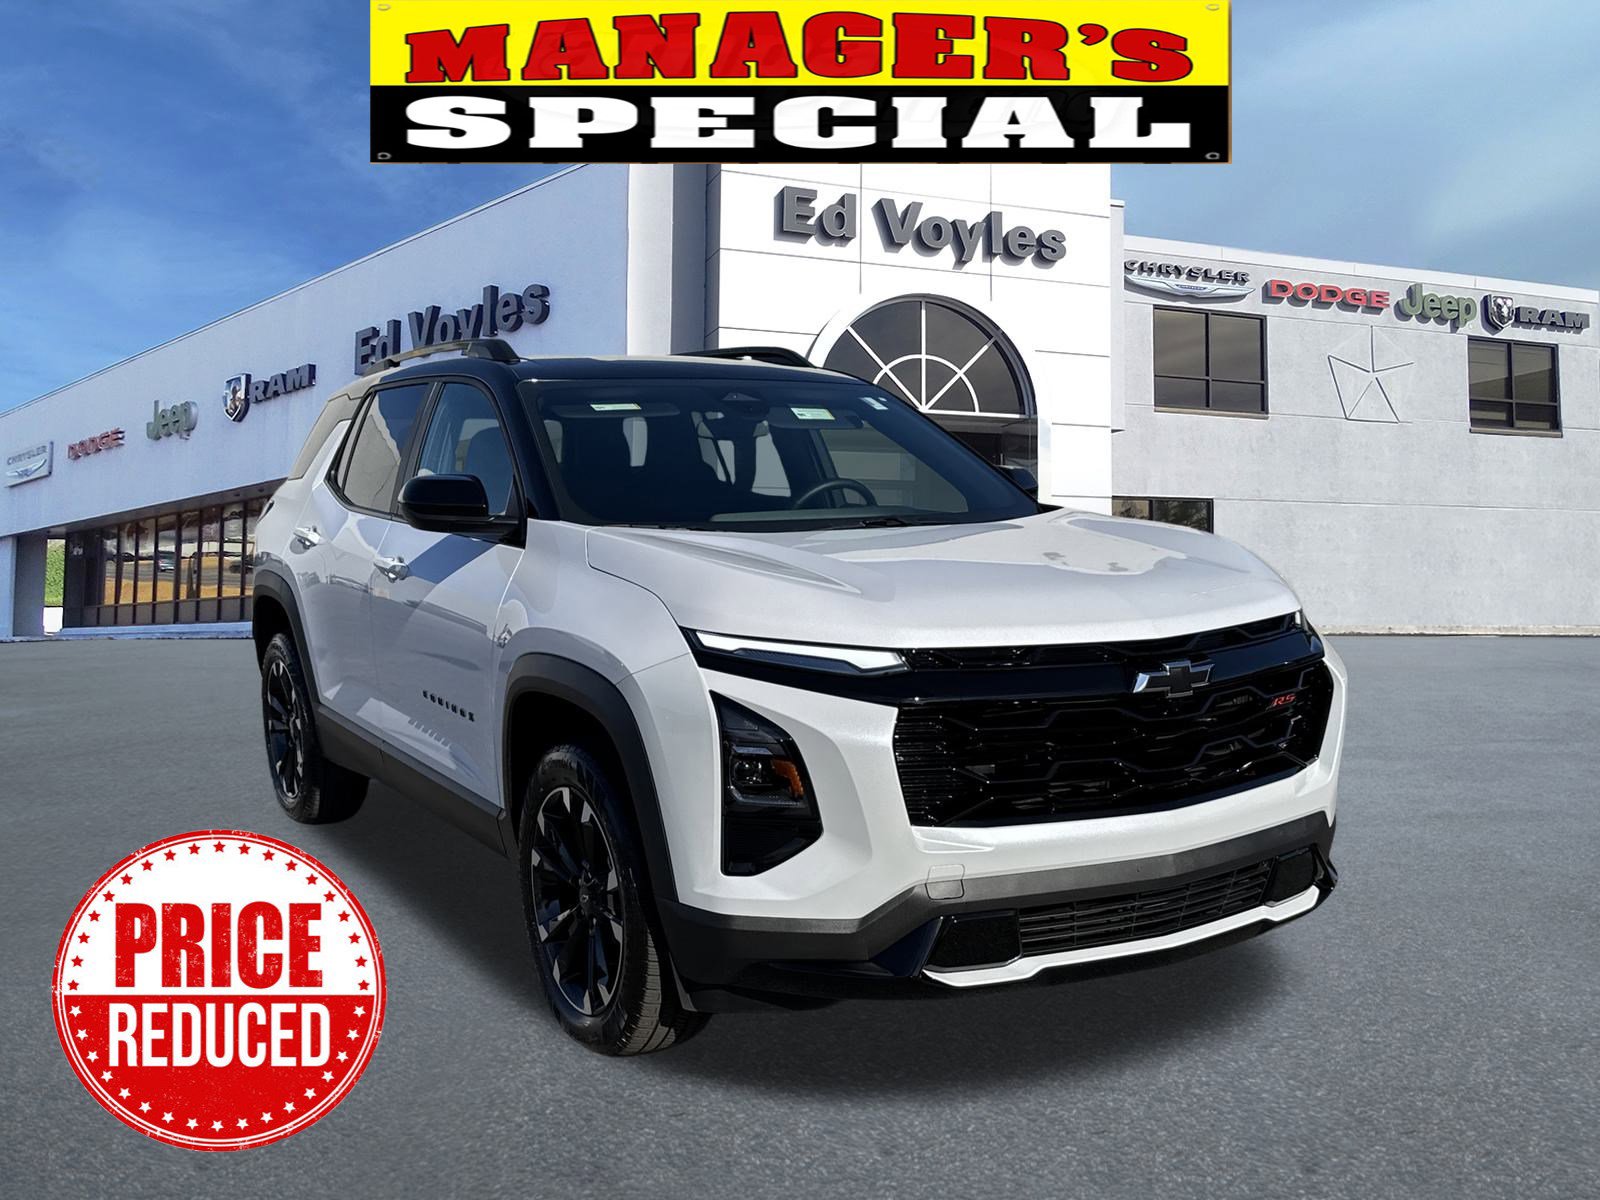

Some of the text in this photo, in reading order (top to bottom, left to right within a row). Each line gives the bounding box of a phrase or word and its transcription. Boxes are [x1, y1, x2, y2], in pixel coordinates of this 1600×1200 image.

[776, 186, 1067, 266] Ed Voyles
[1124, 259, 1251, 285] CHRYSLER
[1263, 279, 1390, 313] DODGE
[1399, 283, 1477, 329] Jeep
[355, 284, 550, 375] Ed Voyles
[1515, 306, 1590, 331] RAM
[249, 363, 316, 404] RAM
[146, 400, 198, 441] Jeep
[7, 445, 48, 466] CHRYSLER
[68, 427, 125, 460] DODGE
